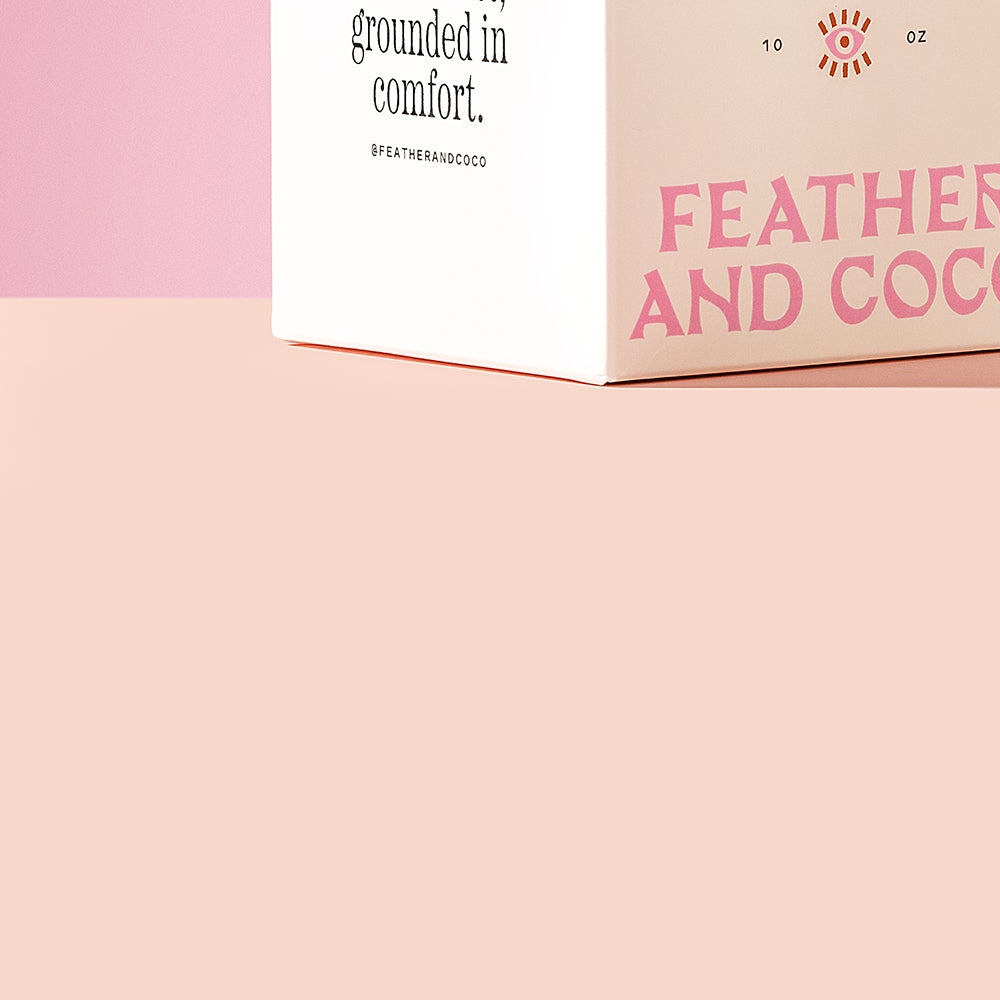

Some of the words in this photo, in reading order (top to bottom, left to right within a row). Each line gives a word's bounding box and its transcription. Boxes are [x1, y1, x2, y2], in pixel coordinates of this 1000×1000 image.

[351, 8, 473, 65] grounded
[481, 13, 508, 64] in
[762, 38, 783, 52] 10
[906, 30, 927, 44] OZ
[373, 67, 483, 124] comfort.
[371, 143, 487, 168] @FEATHERANDCOCO
[629, 263, 804, 340] AND
